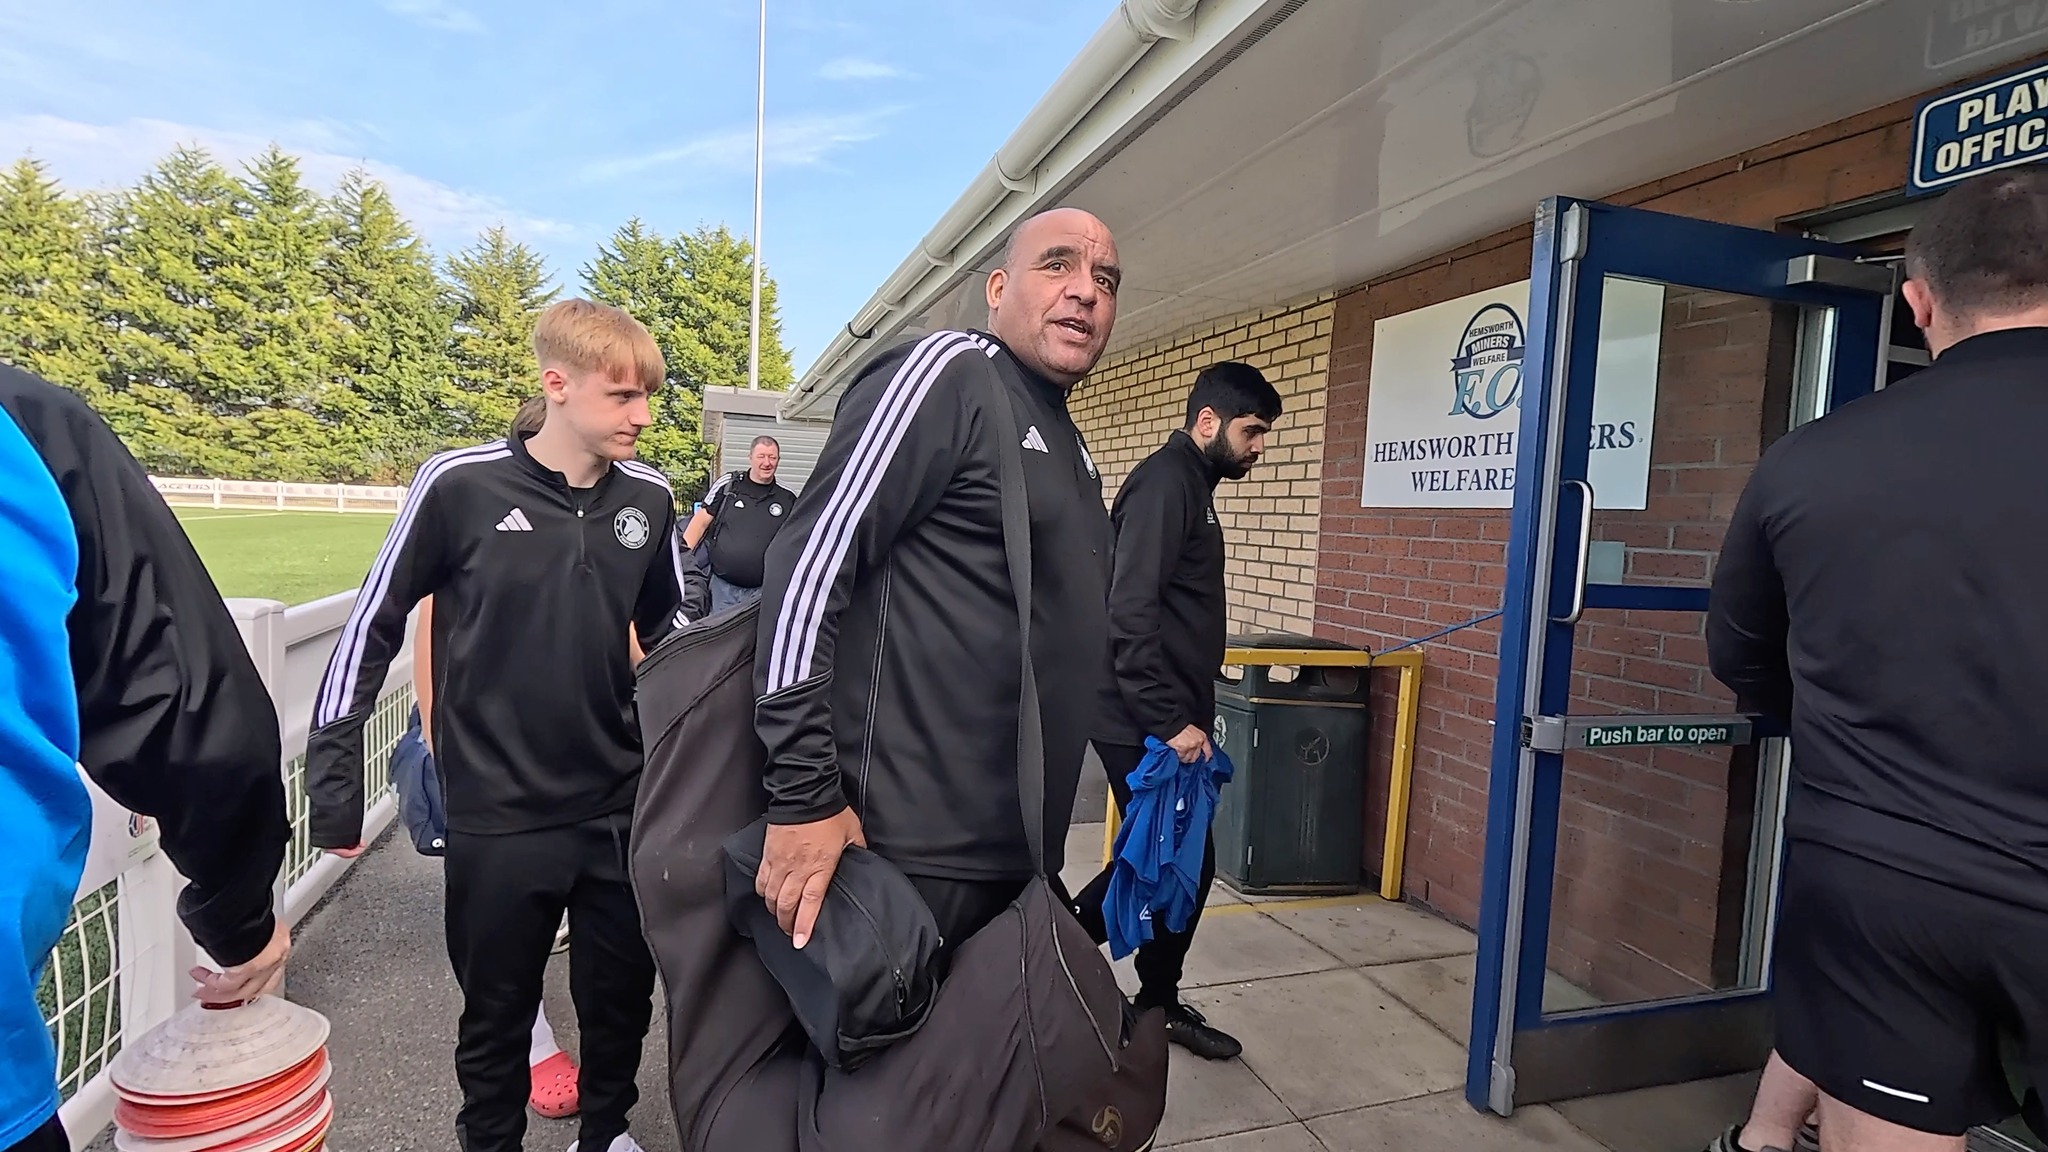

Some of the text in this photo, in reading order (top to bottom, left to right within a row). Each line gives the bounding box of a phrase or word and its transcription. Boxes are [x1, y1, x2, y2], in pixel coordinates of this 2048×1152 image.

[1935, 118, 2048, 174] OFFIC
[1468, 320, 1515, 338] HEMSWORTH
[1471, 335, 1511, 355] MINERS
[1472, 353, 1506, 367] WELFARE
[1373, 431, 1515, 463] HEMSWORTH
[1411, 467, 1516, 493] WELFARE
[1589, 724, 1728, 745] Push bar to open
